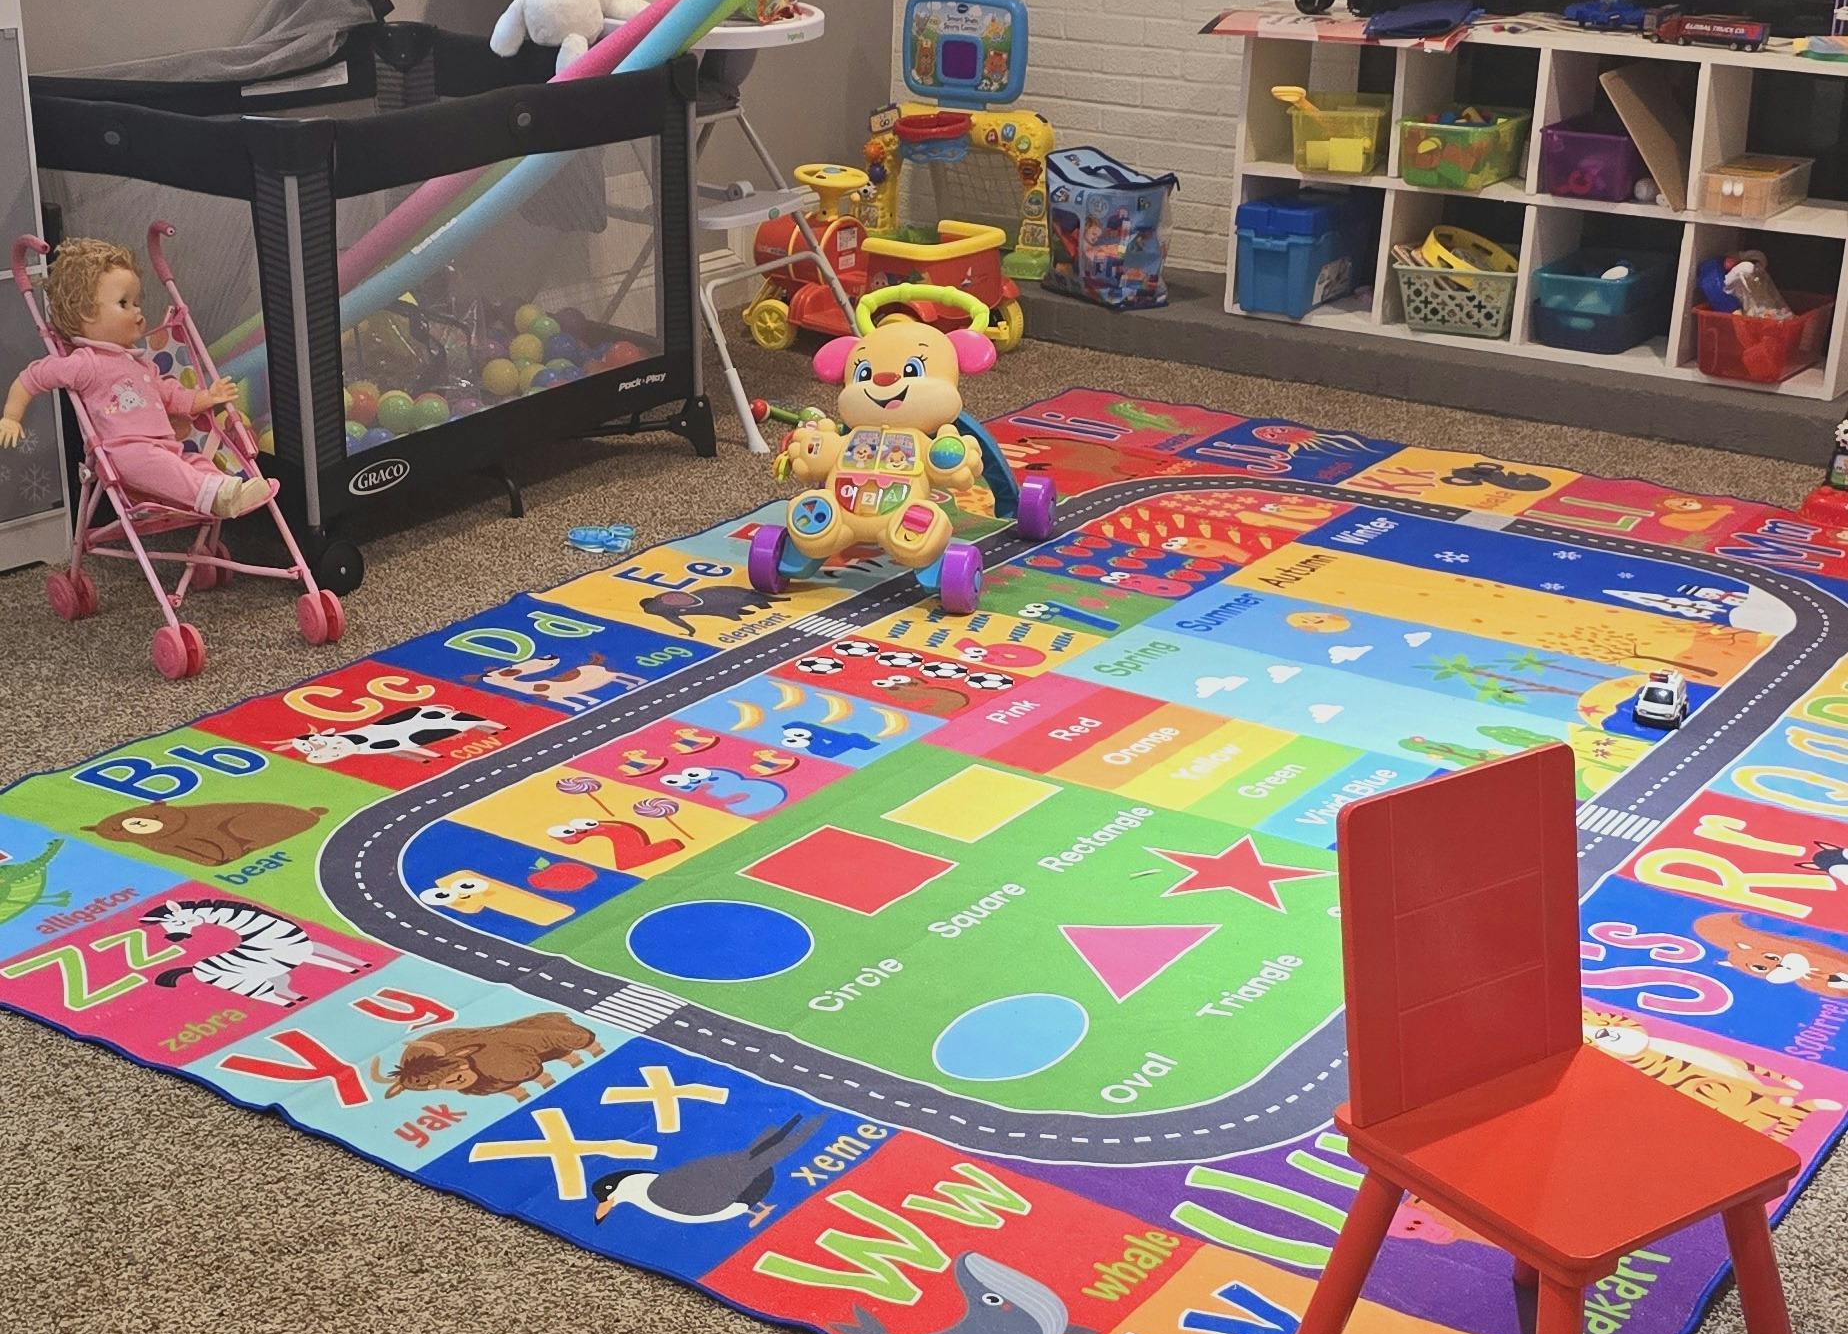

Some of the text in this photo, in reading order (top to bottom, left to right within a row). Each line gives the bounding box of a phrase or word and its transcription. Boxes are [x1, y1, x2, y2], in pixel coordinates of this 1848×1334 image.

[1685, 22, 1711, 32] GLOBAL
[1712, 24, 1734, 34] TRUCK
[618, 377, 641, 392] Pack
[645, 372, 667, 384] Play
[357, 463, 404, 489] GRACO
[1331, 517, 1400, 545] Winter
[1714, 518, 1846, 569] Mm
[612, 560, 736, 591] Ee
[1257, 552, 1340, 589] Autumn
[444, 607, 606, 662] Dd
[717, 610, 793, 645] elephant
[1175, 592, 1266, 633] Summer
[636, 644, 694, 668] dog
[1093, 640, 1182, 678] Spring
[283, 674, 436, 724] Cc
[986, 698, 1042, 725] Pink
[450, 734, 502, 762] cow
[1047, 716, 1103, 742] Red
[1102, 725, 1181, 766] Orange
[71, 741, 270, 803] Bb
[1169, 742, 1244, 781] Yellow
[1237, 762, 1308, 800] Green
[1295, 768, 1399, 827] Vivid Blue
[1037, 803, 1155, 875] Rectangle
[215, 847, 290, 888] bear
[1633, 814, 1838, 918] Rr
[34, 882, 139, 935] alligator
[928, 880, 1026, 940] Square
[0, 928, 185, 1013] Zz
[808, 956, 904, 1014] Circle
[1195, 951, 1305, 1019] Triangle
[157, 1004, 249, 1053] zebra
[1101, 1049, 1179, 1107] Oval
[394, 1103, 469, 1149] yak
[469, 1065, 730, 1201] Xx
[790, 1122, 889, 1187] xeme
[754, 1161, 1032, 1307] Ww
[1081, 1226, 1181, 1303] whale
